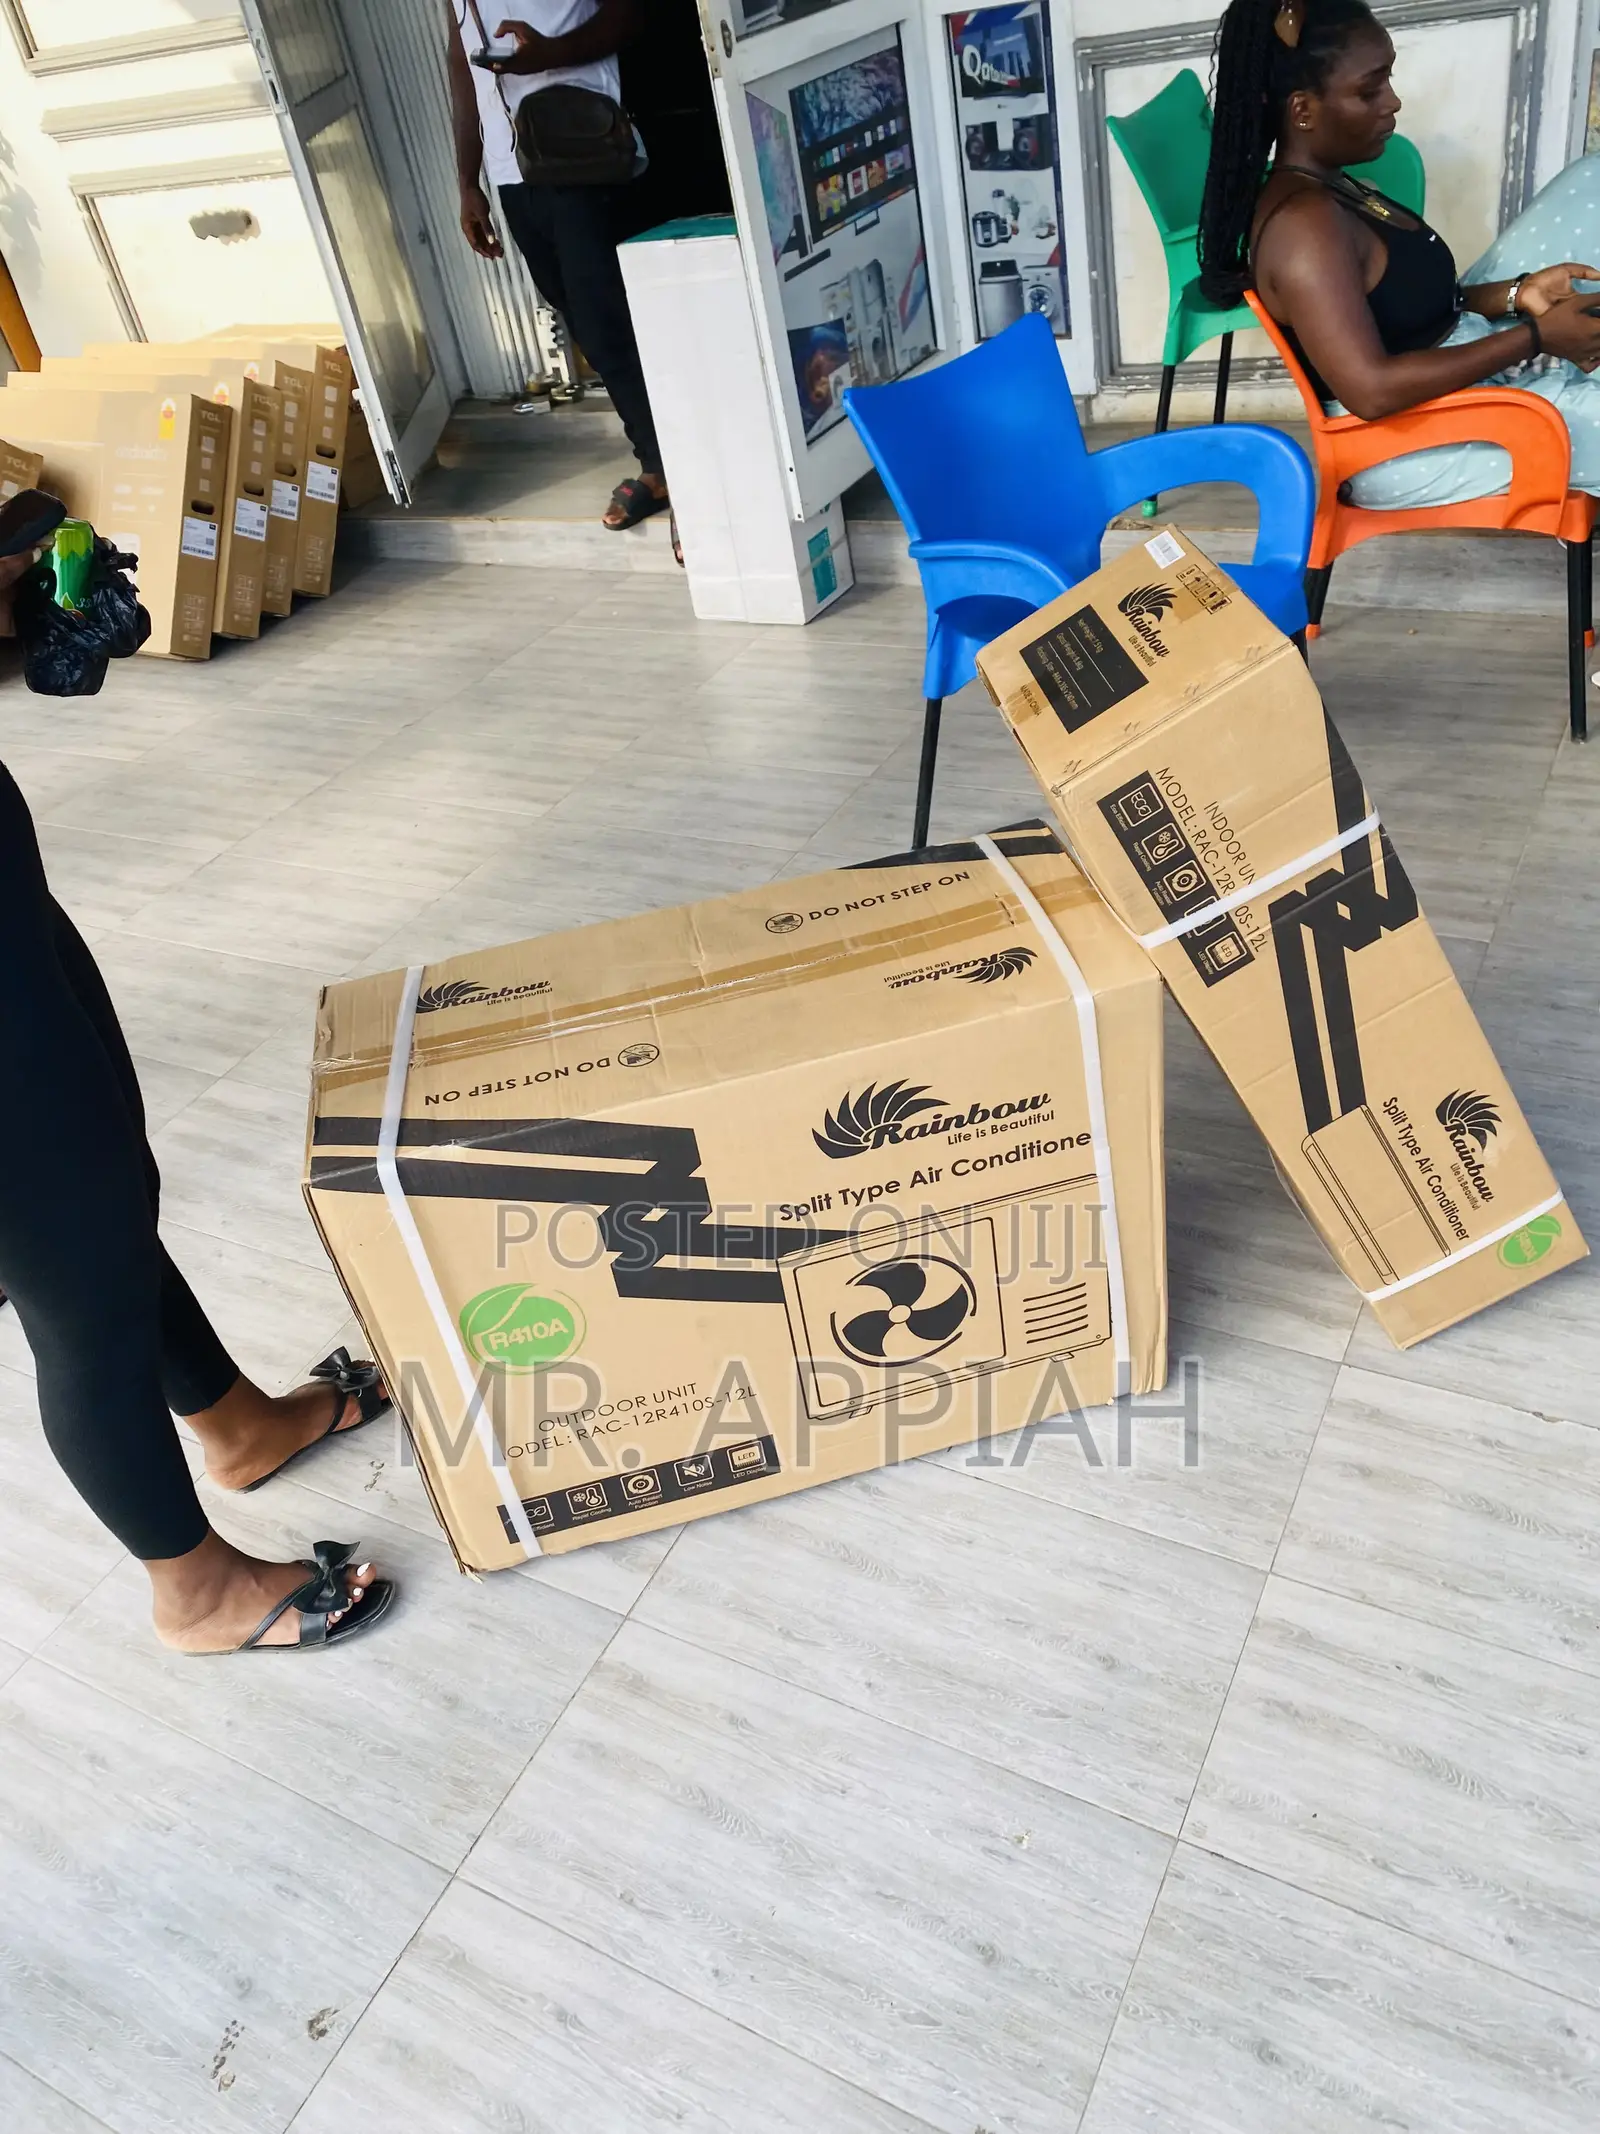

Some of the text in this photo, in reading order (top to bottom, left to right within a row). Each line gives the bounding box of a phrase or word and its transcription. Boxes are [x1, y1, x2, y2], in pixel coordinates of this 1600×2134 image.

[1125, 604, 1170, 658] Rainbow
[1156, 767, 1198, 833] MODEL:
[1132, 841, 1152, 872] Rapid Cooling
[1204, 801, 1257, 886] INDOOR UN
[808, 870, 969, 921] DO NOT STEP ON
[1152, 888, 1164, 905] Function
[1154, 880, 1165, 891] Auto
[1197, 950, 1214, 975] LED Display
[1219, 943, 1233, 958] LED
[883, 968, 923, 982] Beautiful
[888, 953, 1005, 990] Rainbow
[436, 981, 550, 1009] Rainbow
[513, 987, 552, 1000] Beautiful
[423, 1057, 611, 1106] DO NOT STEP ON
[862, 1093, 1052, 1150] Rainbow
[948, 1110, 1055, 1146] Life is Beautiful
[779, 1132, 1092, 1223] Split Type Air Conditione
[1383, 1096, 1470, 1241] Split Type Air Conditioner
[1444, 1118, 1494, 1202] Rainbow
[1450, 1162, 1461, 1176] Life
[1460, 1181, 1480, 1210] Beautiful
[490, 1317, 568, 1351] R410A
[538, 1383, 697, 1433] OUTDOOR UNIT
[503, 1434, 571, 1460] ODEL:
[737, 1451, 755, 1460] LED
[572, 1507, 611, 1520] Rapid Cooling
[634, 1500, 658, 1508] Function
